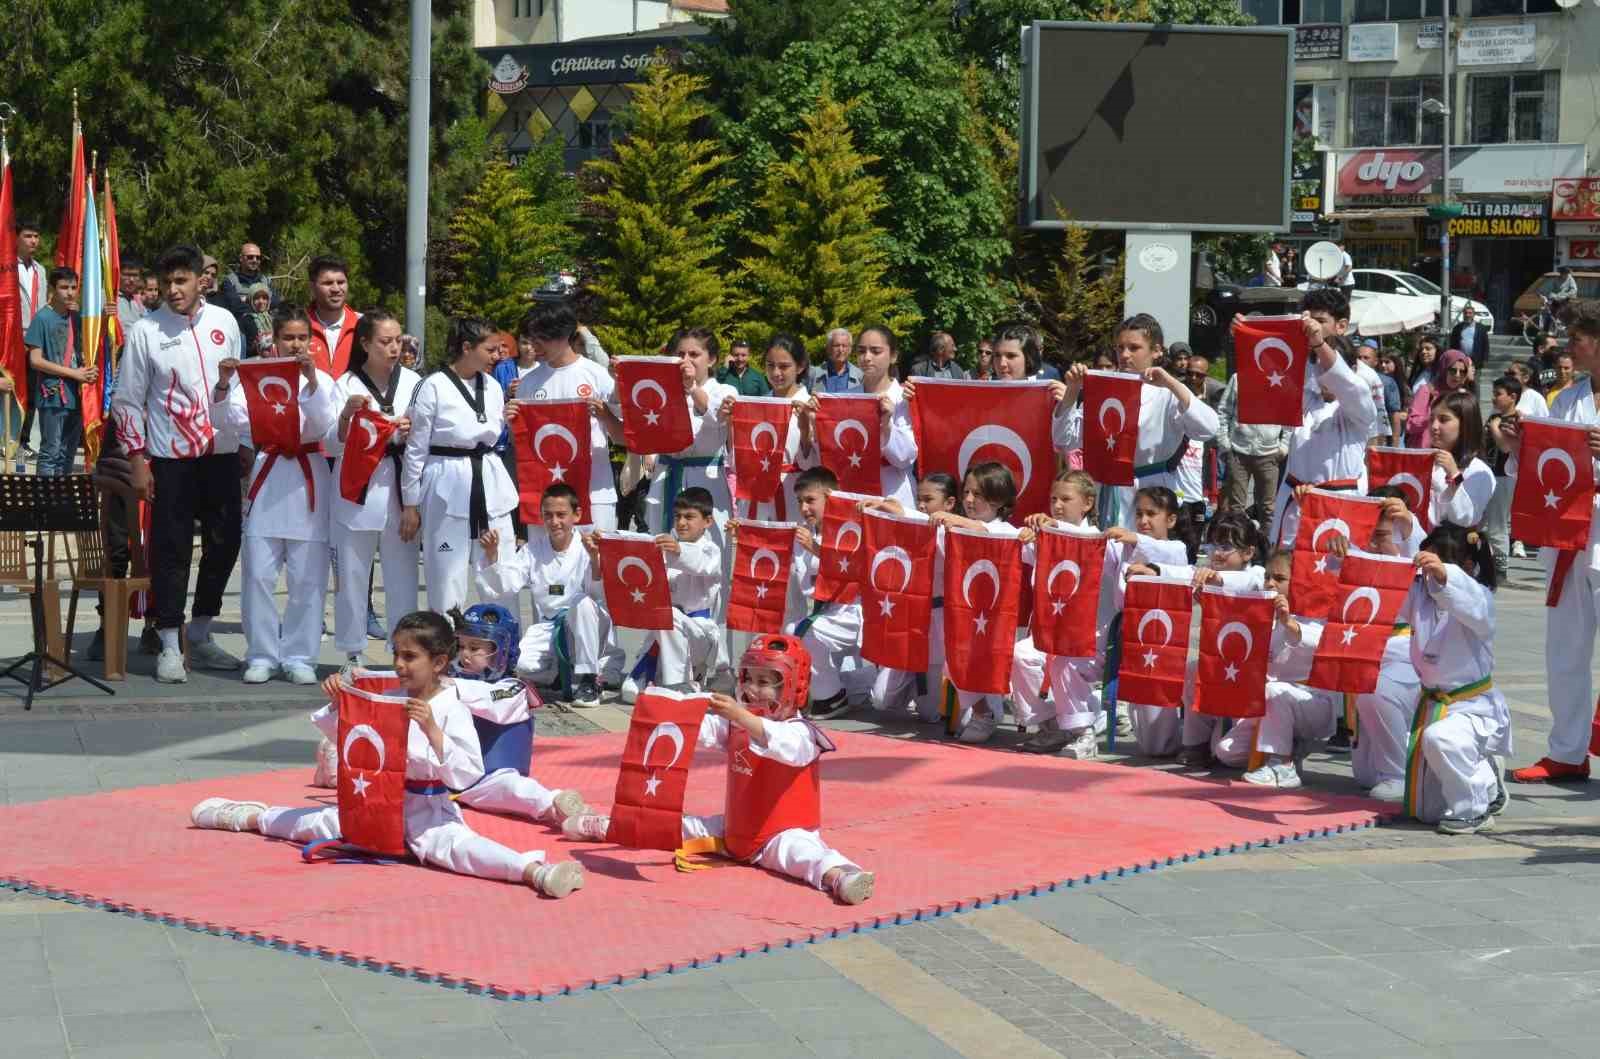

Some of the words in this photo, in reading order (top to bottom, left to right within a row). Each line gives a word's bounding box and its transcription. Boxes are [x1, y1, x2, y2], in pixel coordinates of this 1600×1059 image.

[551, 56, 616, 76] Çiftlikten
[1358, 152, 1424, 190] dyo
[1448, 219, 1488, 237] ÇORBA
[1490, 219, 1541, 235] SALONU
